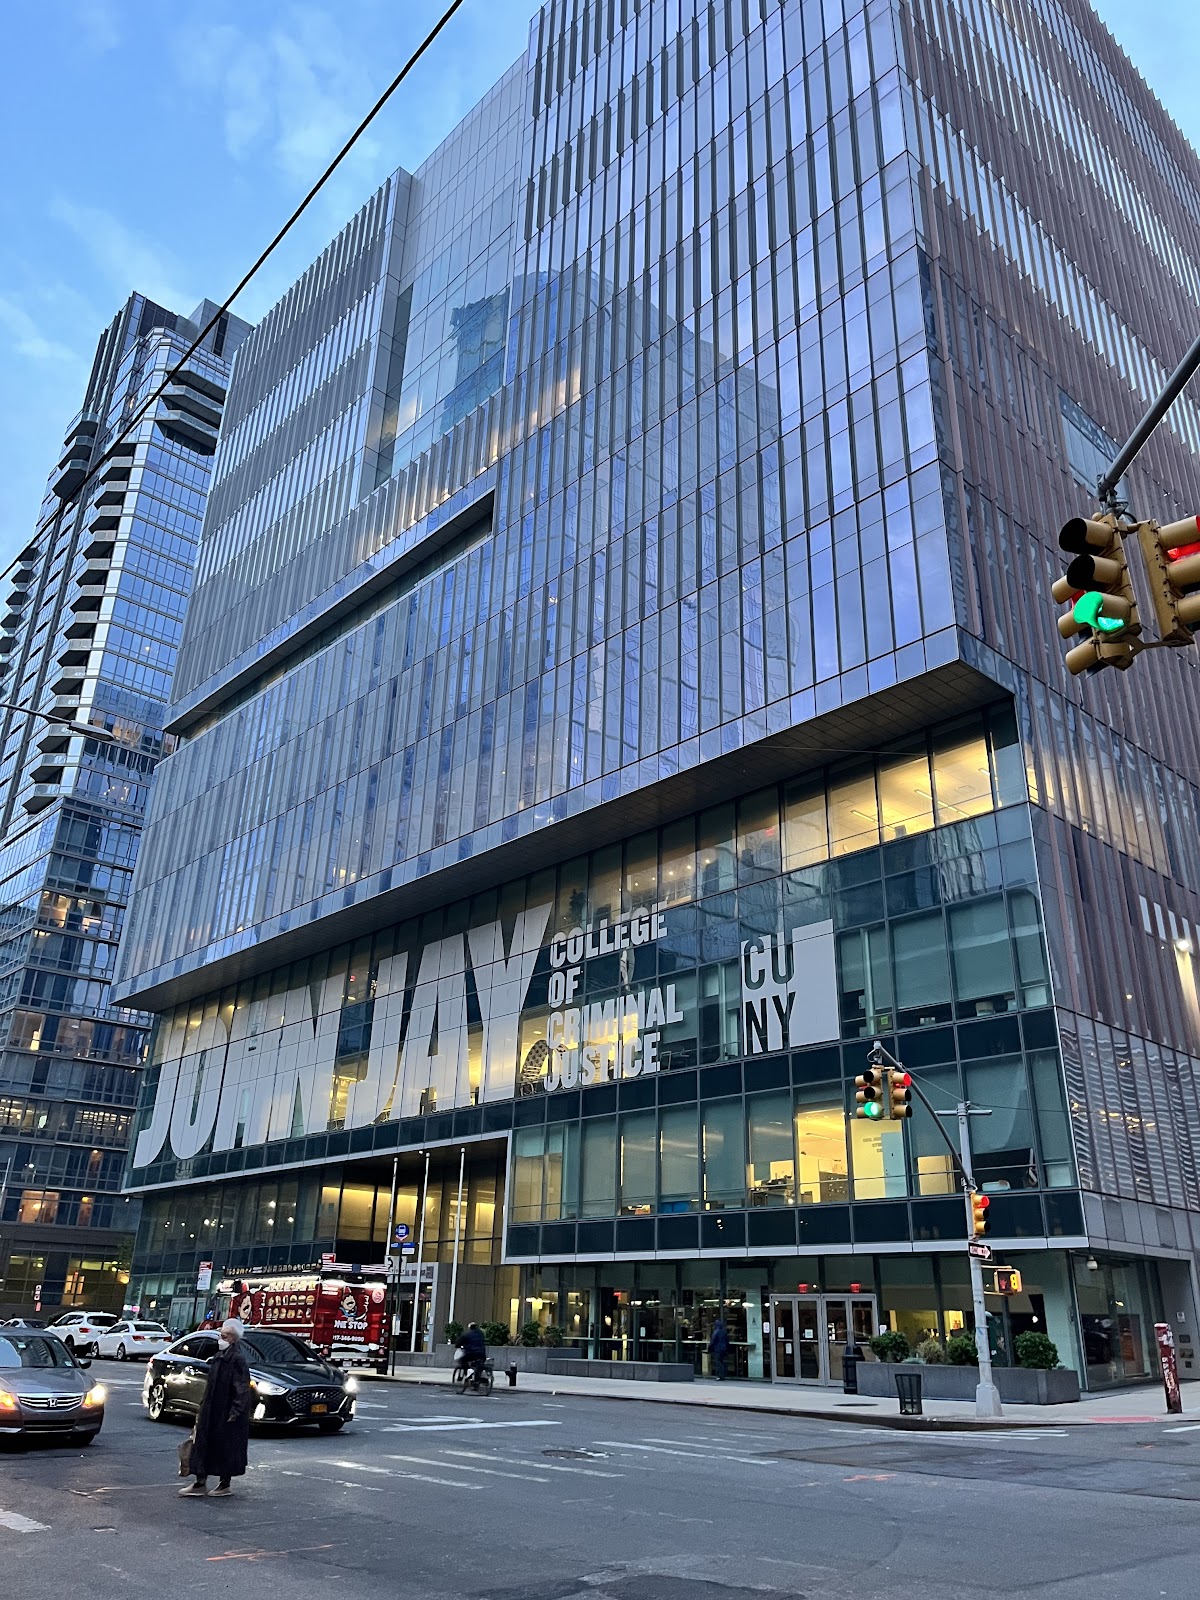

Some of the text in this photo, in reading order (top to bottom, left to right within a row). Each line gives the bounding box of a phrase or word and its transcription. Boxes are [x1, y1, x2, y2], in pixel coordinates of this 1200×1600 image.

[551, 901, 668, 968] COLLEGE
[744, 933, 795, 990] CU
[547, 984, 684, 1050] CRIMINAL
[548, 970, 582, 1009] OF
[133, 902, 553, 1168] JOHN JAY
[744, 991, 797, 1057] NY
[544, 1032, 661, 1092] JUSTICE
[348, 1321, 368, 1330] STOP
